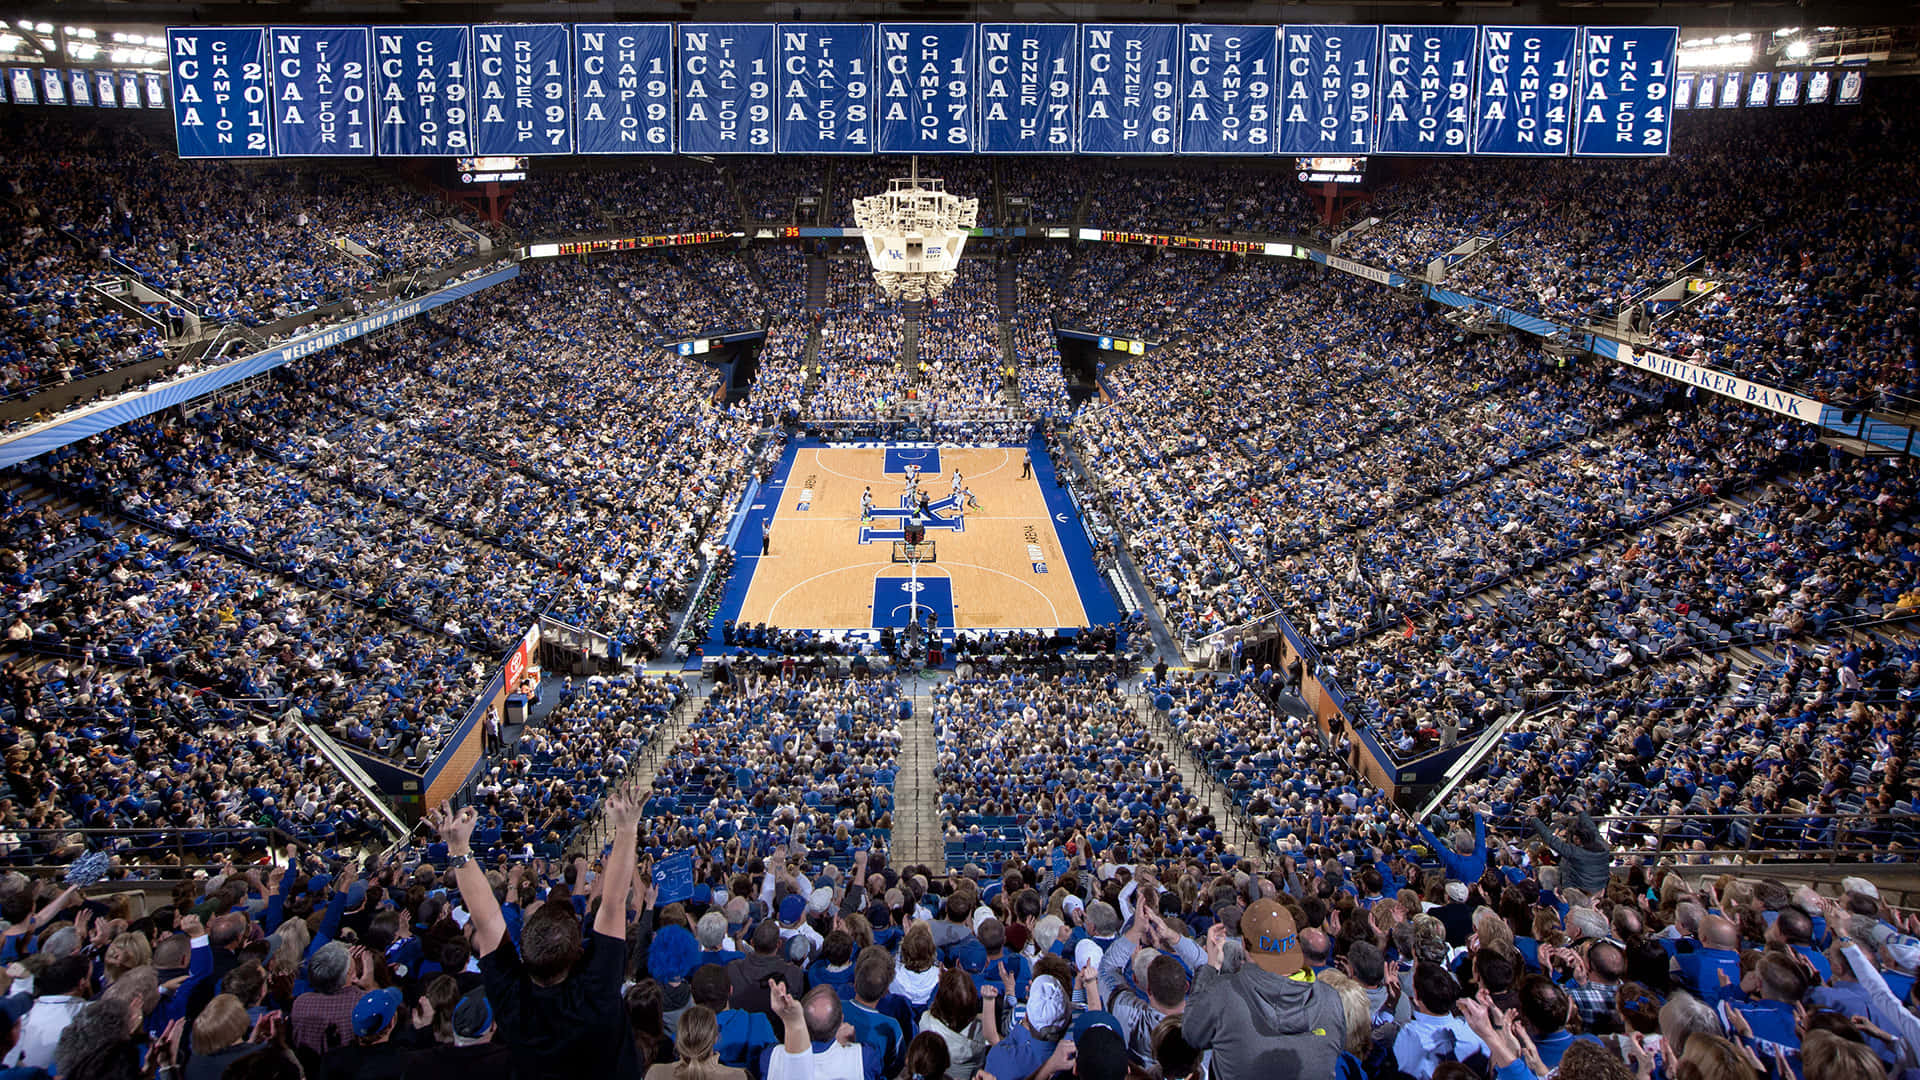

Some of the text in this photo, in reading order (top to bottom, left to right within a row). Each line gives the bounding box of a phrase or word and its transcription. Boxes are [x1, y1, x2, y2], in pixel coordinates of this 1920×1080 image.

[175, 38, 203, 125] NCAA
[212, 42, 232, 142] CHAMPION
[243, 62, 267, 150] 2012
[278, 36, 304, 123] NCAA
[317, 42, 336, 142] FINAL FOUR
[344, 62, 364, 148] 2011
[379, 36, 405, 124] NCAA
[416, 42, 437, 146] CHAMPION
[446, 61, 467, 147] 1998
[480, 34, 504, 122] NCAA
[515, 41, 533, 141] RUNNER UP
[545, 60, 565, 144] 1997
[582, 33, 606, 120] NCAA
[619, 37, 638, 141] CHAMPION
[647, 58, 666, 143] 1996
[686, 33, 708, 120] NCAA
[719, 39, 736, 140] FINAL FOUR
[750, 59, 769, 144] 1993
[785, 33, 808, 120] NCAA
[818, 38, 835, 139] FINAL FOUR
[847, 59, 866, 144] 1984
[886, 32, 910, 120] NCAA
[920, 36, 939, 140] CHAMPION
[948, 58, 967, 143] 1978
[986, 33, 1010, 120] NCAA
[1021, 40, 1038, 139] RUNNER UP
[1049, 58, 1069, 144] 1975
[1088, 31, 1113, 118] NCAA
[1124, 40, 1142, 140] RUNNER UP
[1152, 59, 1172, 144] 1966
[1188, 34, 1212, 120] NCAA
[1222, 38, 1240, 140] CHAMPION
[1248, 59, 1268, 144] 1958
[1286, 35, 1312, 122] NCAA
[1321, 37, 1341, 141] CHAMPION
[1350, 60, 1370, 144] 1951
[1386, 34, 1413, 122] NCAA
[1419, 38, 1440, 141] CHAMPION
[1446, 60, 1468, 145] 1949
[1484, 32, 1512, 120] NCAA
[1518, 39, 1540, 142] CHAMPION
[1544, 60, 1568, 145] 1948
[1584, 35, 1613, 122] NCAA
[1617, 41, 1636, 141] FINAL FOUR
[1644, 60, 1668, 145] 1942
[786, 226, 799, 237] 35
[282, 303, 421, 361] WELCOME TO RUPP ARENA
[1647, 355, 1803, 416] WHITAKER BANK
[1260, 933, 1296, 952] CATS
